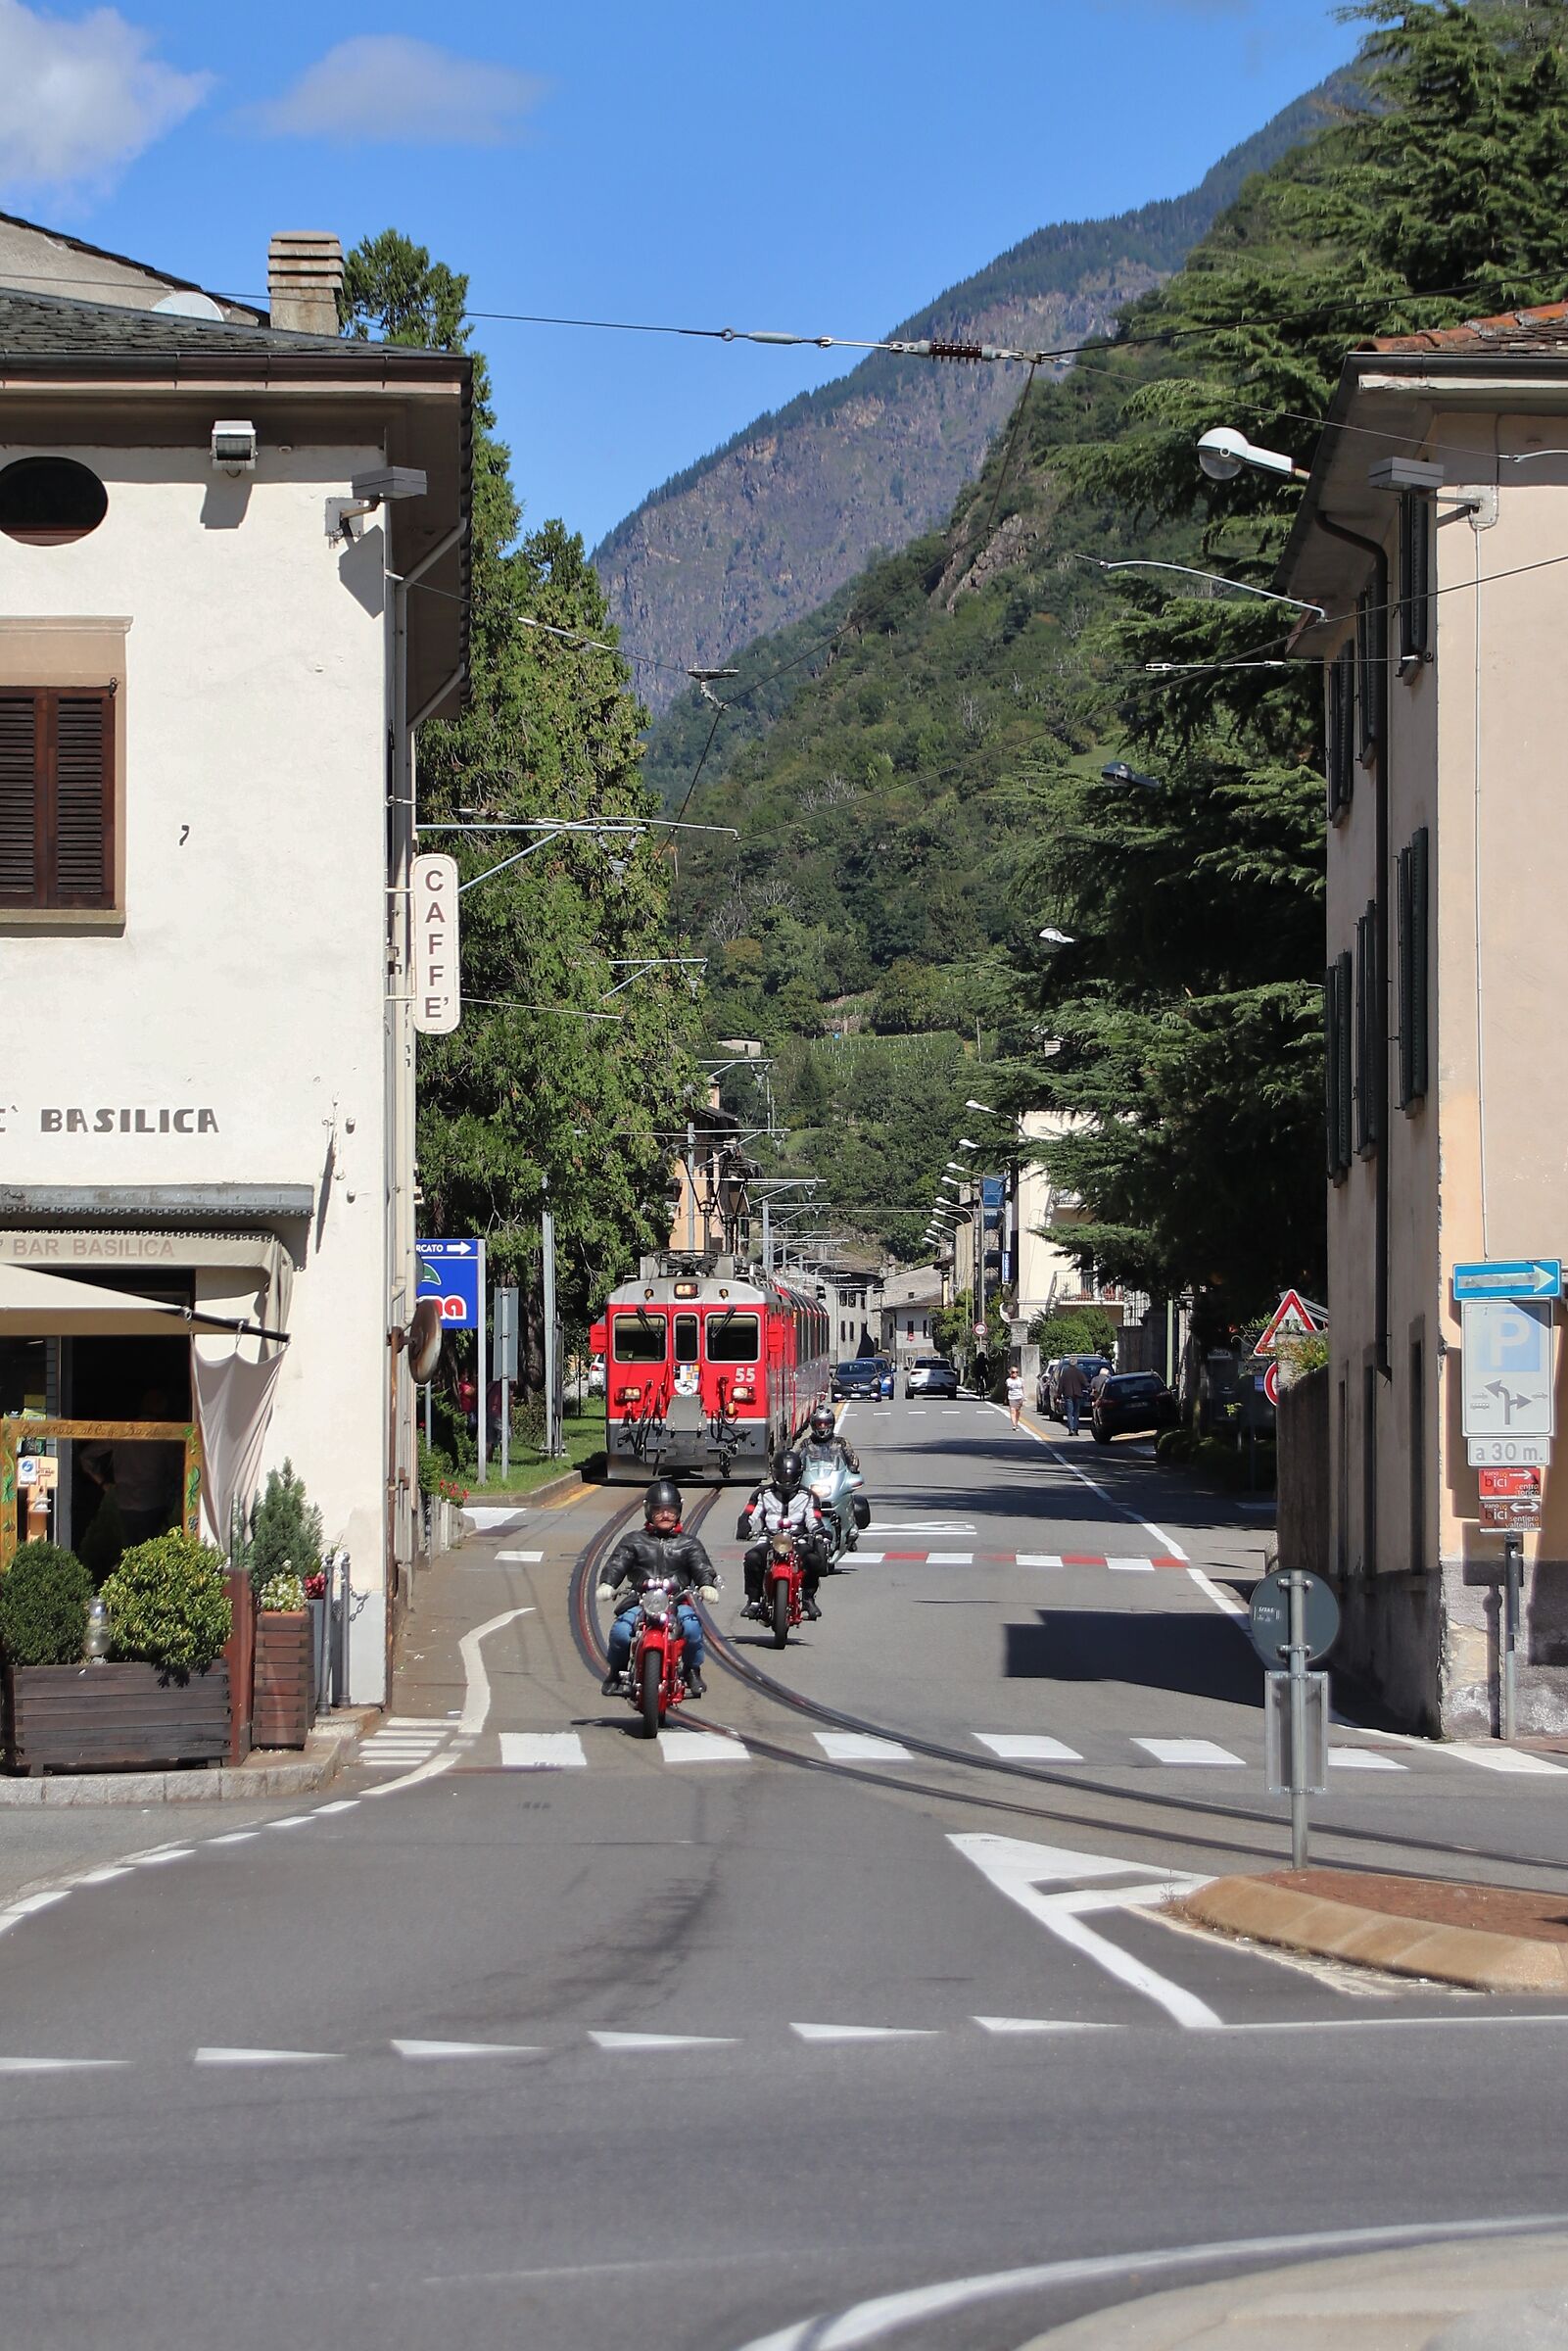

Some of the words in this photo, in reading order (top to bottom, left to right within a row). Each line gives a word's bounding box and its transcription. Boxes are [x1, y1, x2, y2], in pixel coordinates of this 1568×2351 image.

[424, 870, 450, 1018] CAFFE'
[40, 1108, 219, 1133] BASILICA
[13, 1238, 60, 1256] BAR
[72, 1238, 174, 1257] BASILICA
[1490, 1314, 1530, 1367] P
[736, 1367, 755, 1382] 55
[1476, 1447, 1485, 1461] a
[1492, 1442, 1516, 1461] 30
[1523, 1447, 1543, 1461] m.
[1485, 1476, 1507, 1487] bici
[1485, 1509, 1507, 1519] bici
